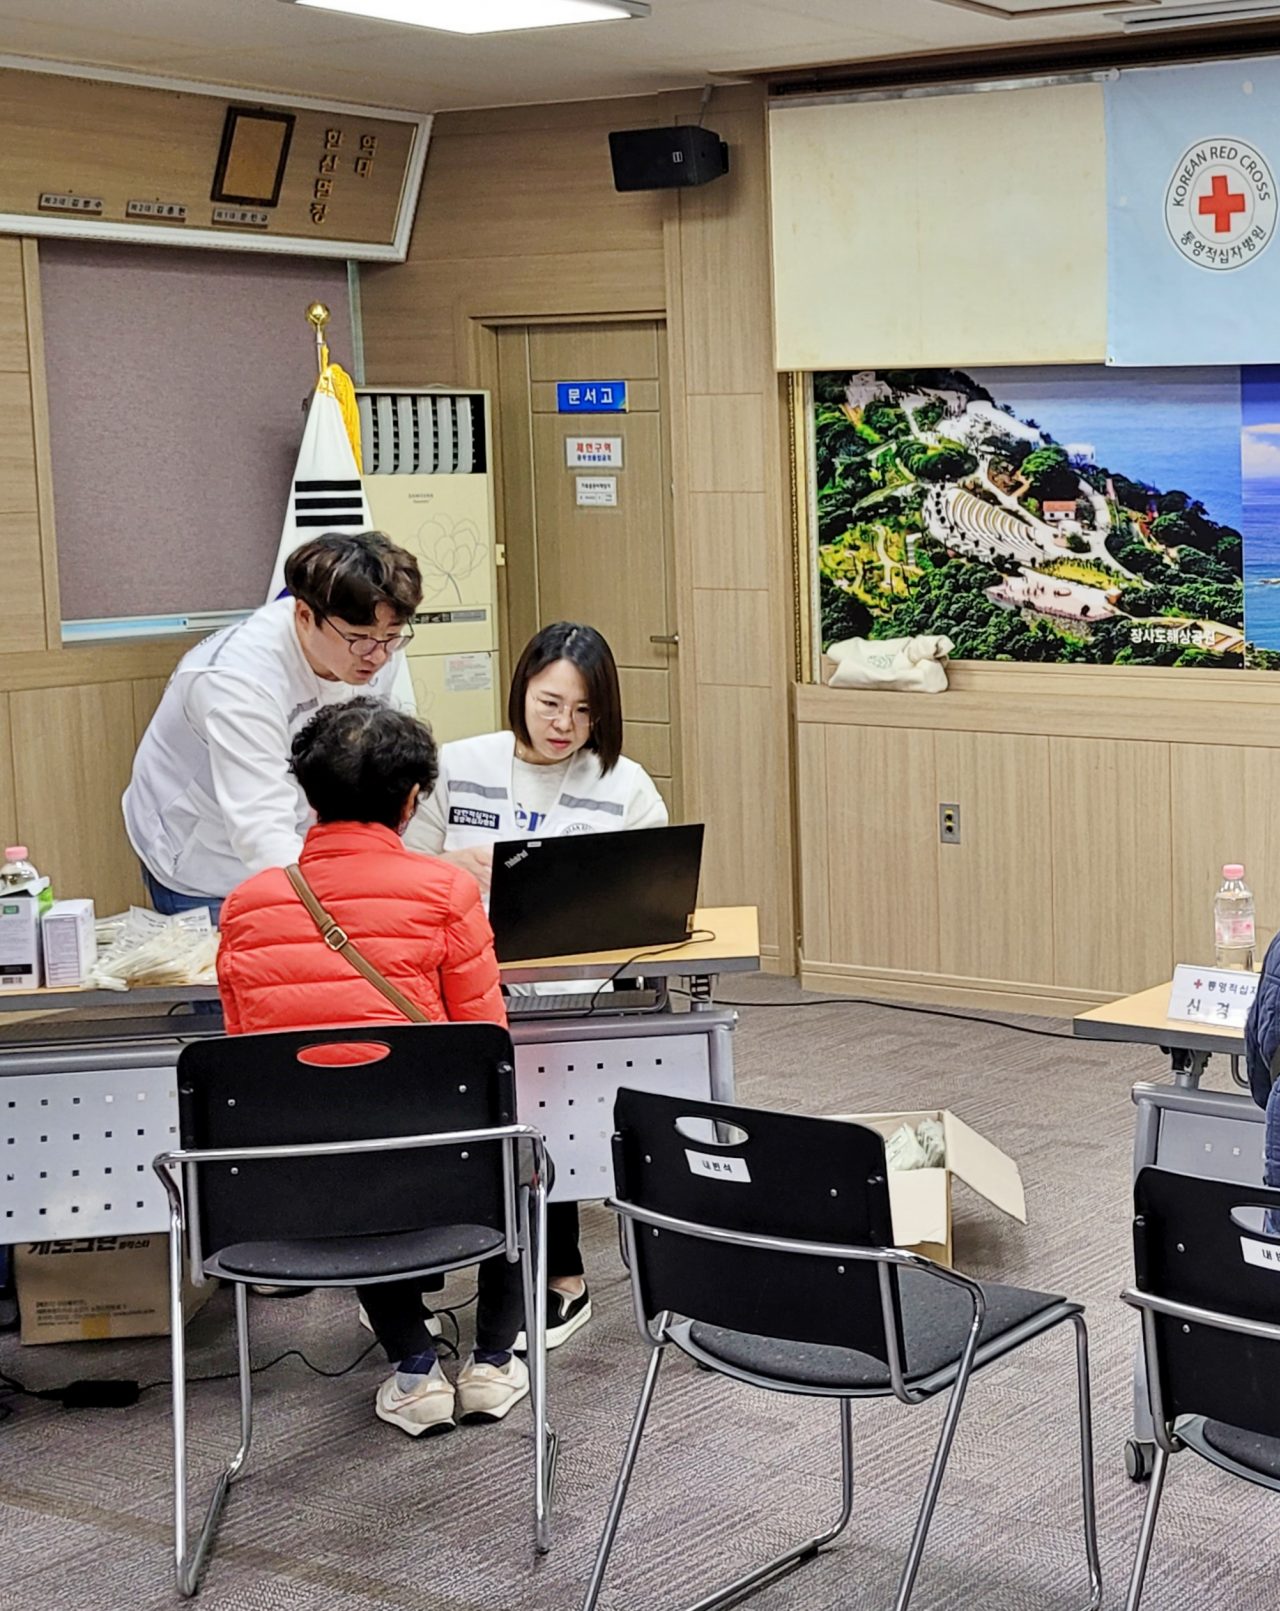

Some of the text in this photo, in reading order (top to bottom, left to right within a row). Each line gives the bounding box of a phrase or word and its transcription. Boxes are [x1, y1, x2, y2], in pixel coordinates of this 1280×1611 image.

[1173, 146, 1270, 207] KOREAN RED CROSS
[1180, 225, 1267, 263] 통영적십자병원
[569, 388, 613, 405] 문서고
[1130, 627, 1216, 645] 장사도해상공원
